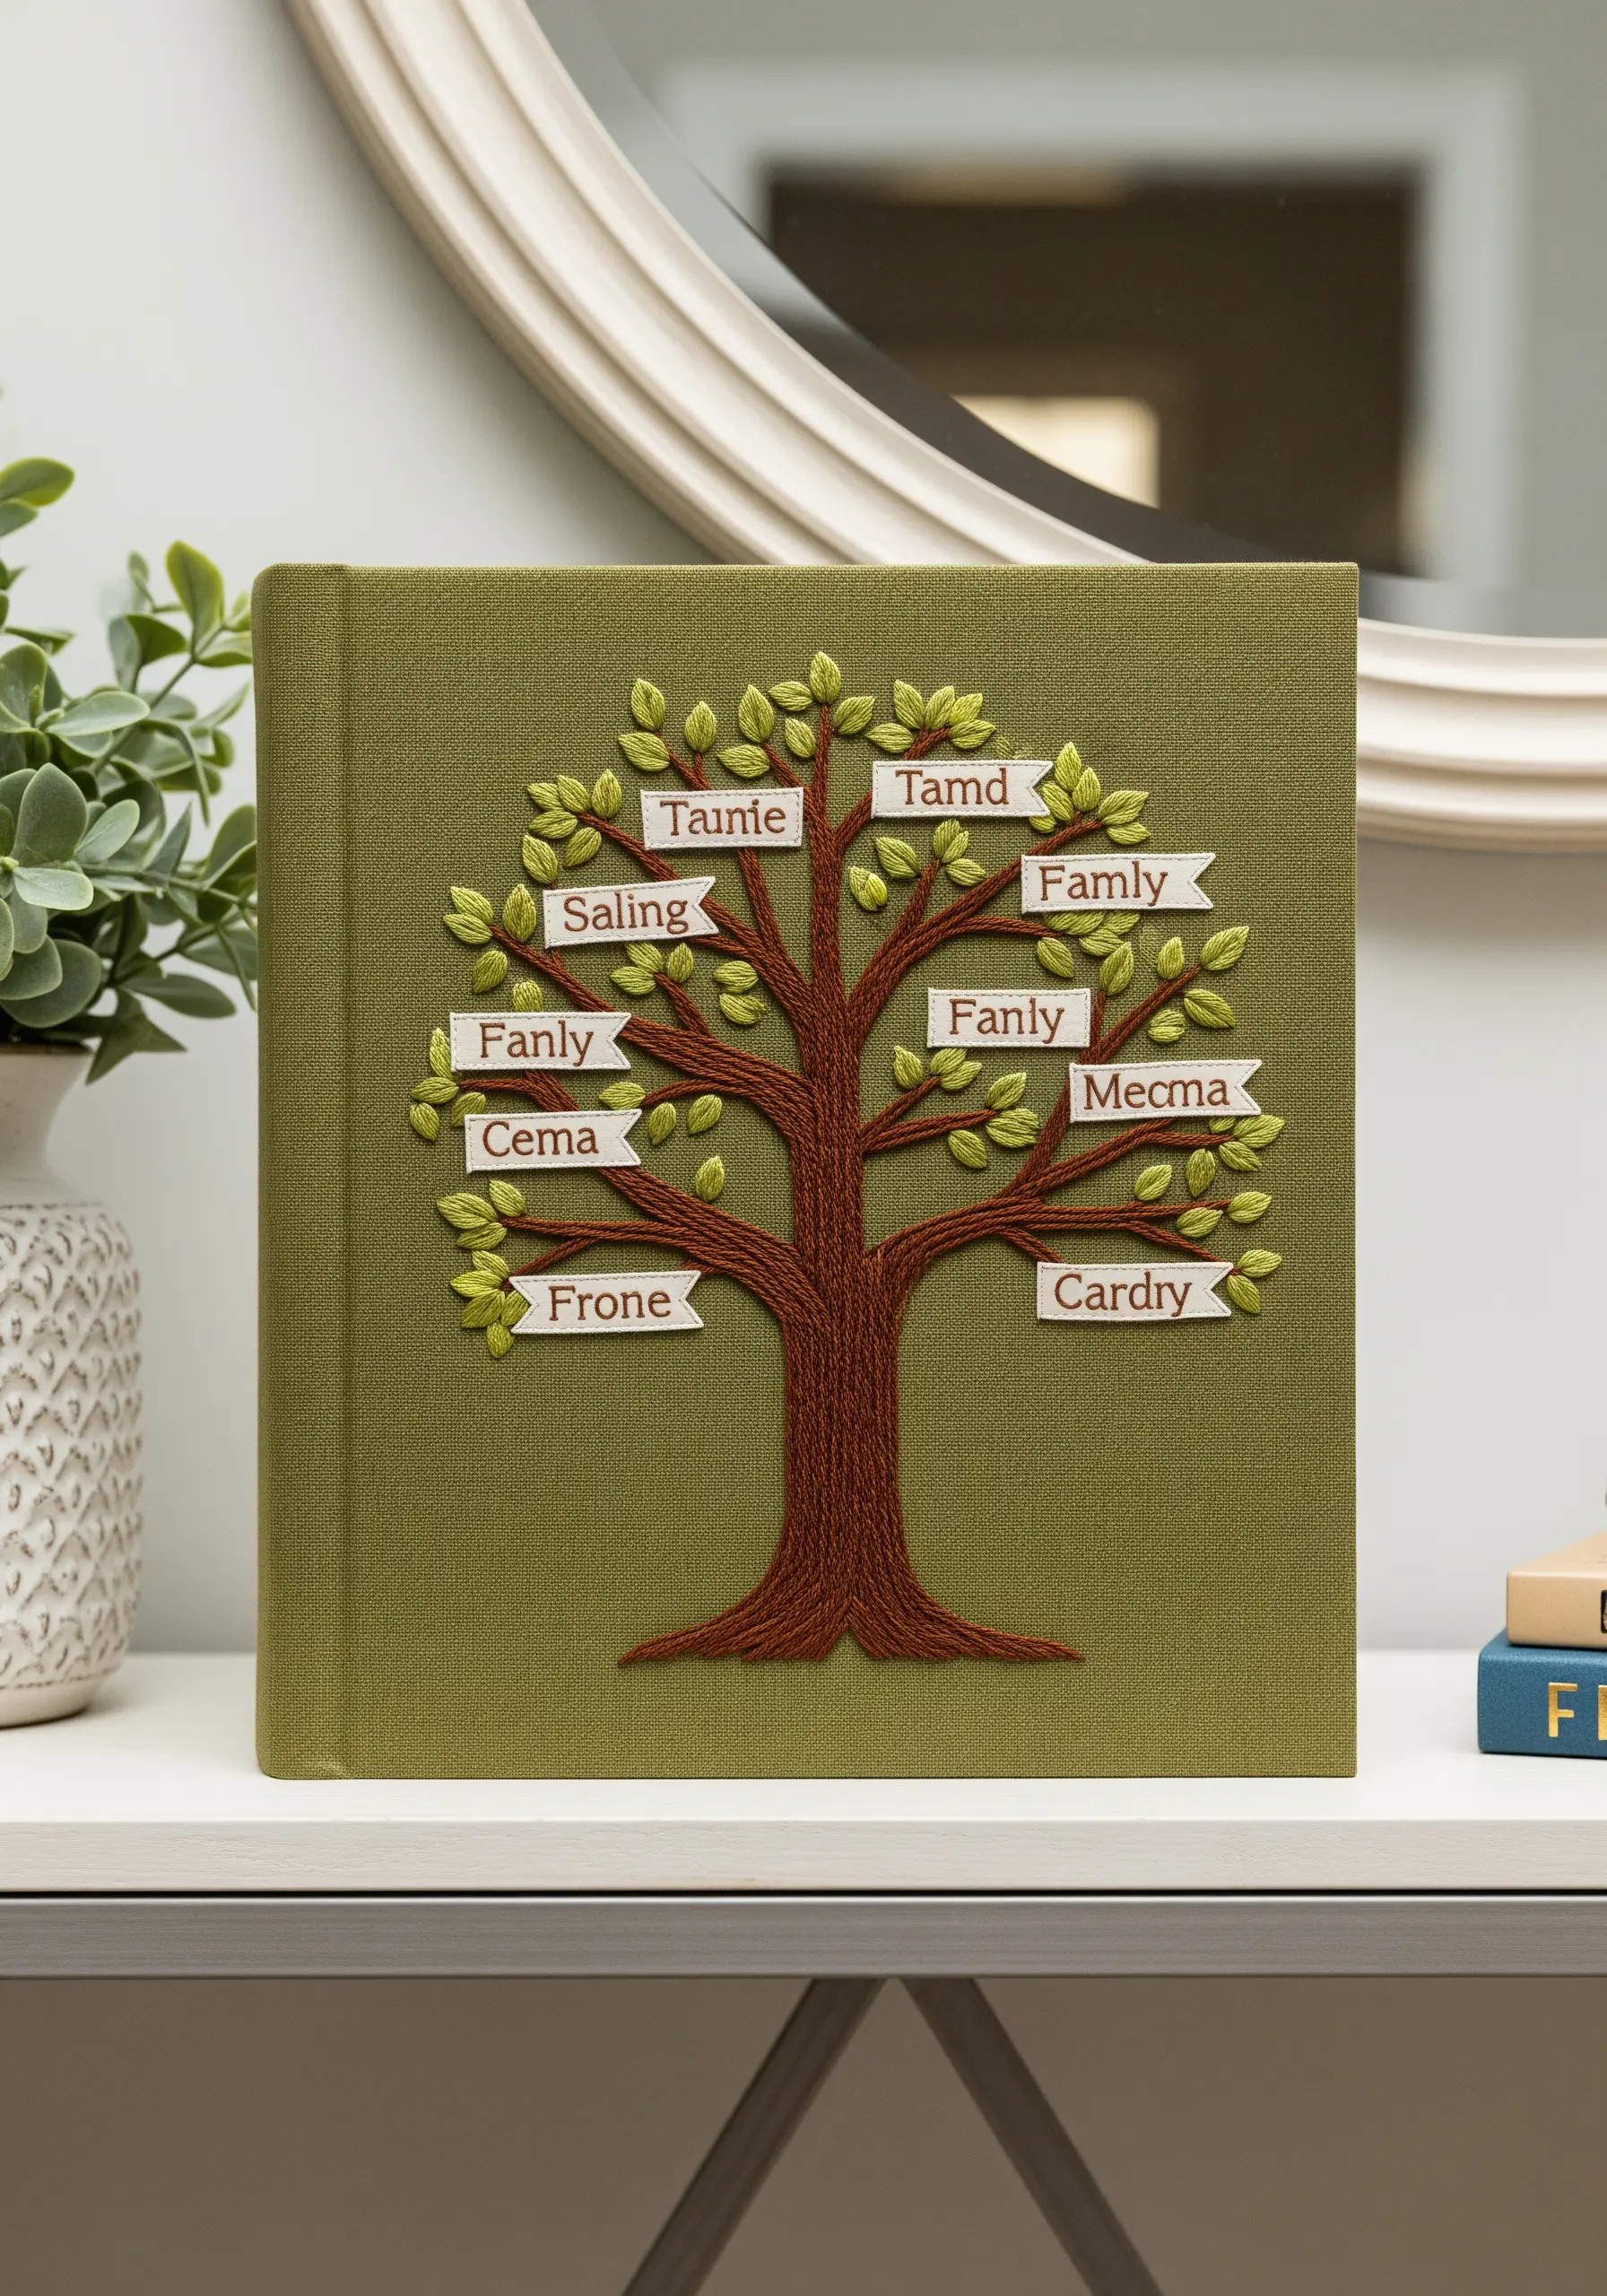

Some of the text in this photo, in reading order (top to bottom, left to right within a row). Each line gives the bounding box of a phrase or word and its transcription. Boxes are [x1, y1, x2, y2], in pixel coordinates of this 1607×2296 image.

[894, 768, 1010, 806] Tamd
[1038, 860, 1168, 907] Famly
[563, 890, 690, 935] Saling
[479, 1020, 595, 1067] Fanly
[949, 997, 1065, 1045] Fanly
[482, 1120, 600, 1158] Cema
[548, 1285, 672, 1321] Frone
[1054, 1271, 1193, 1318] Cardry
[1548, 1682, 1607, 1741] F
